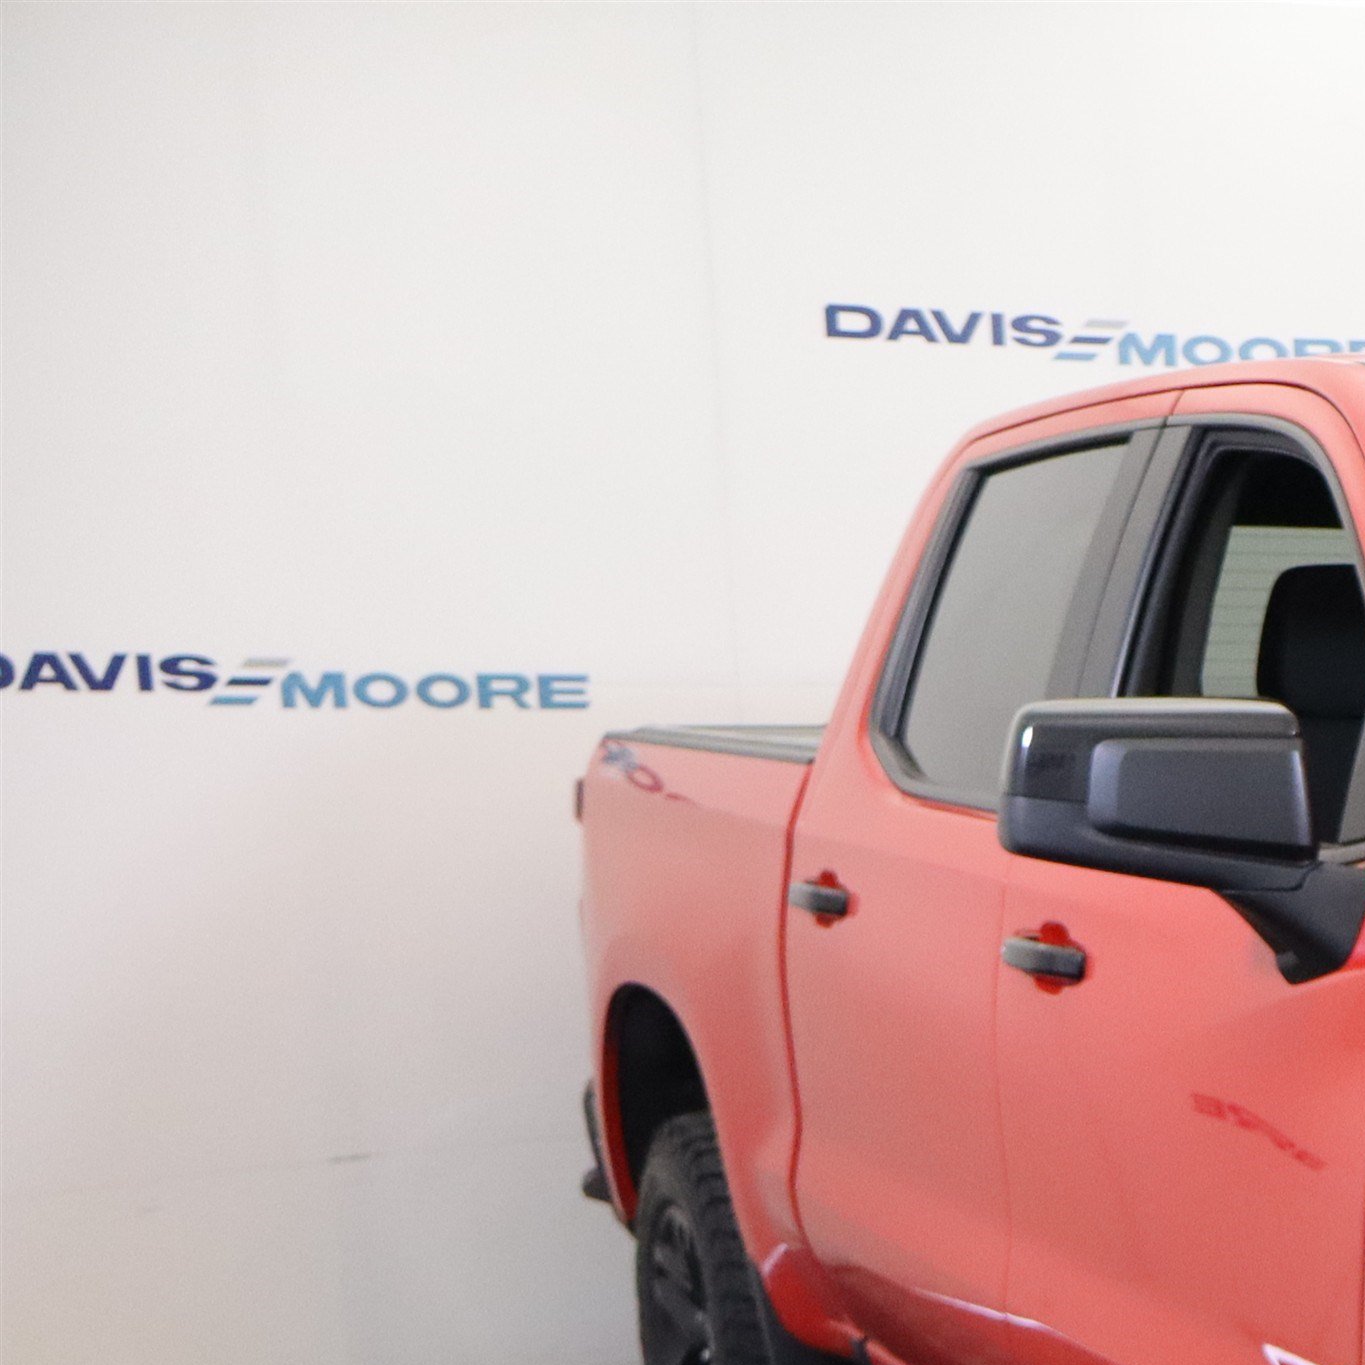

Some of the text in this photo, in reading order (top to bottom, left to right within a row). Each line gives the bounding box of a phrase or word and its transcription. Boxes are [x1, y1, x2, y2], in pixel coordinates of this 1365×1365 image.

[822, 302, 1063, 348] DAVIS
[0, 651, 590, 710] AVIS MOORE
